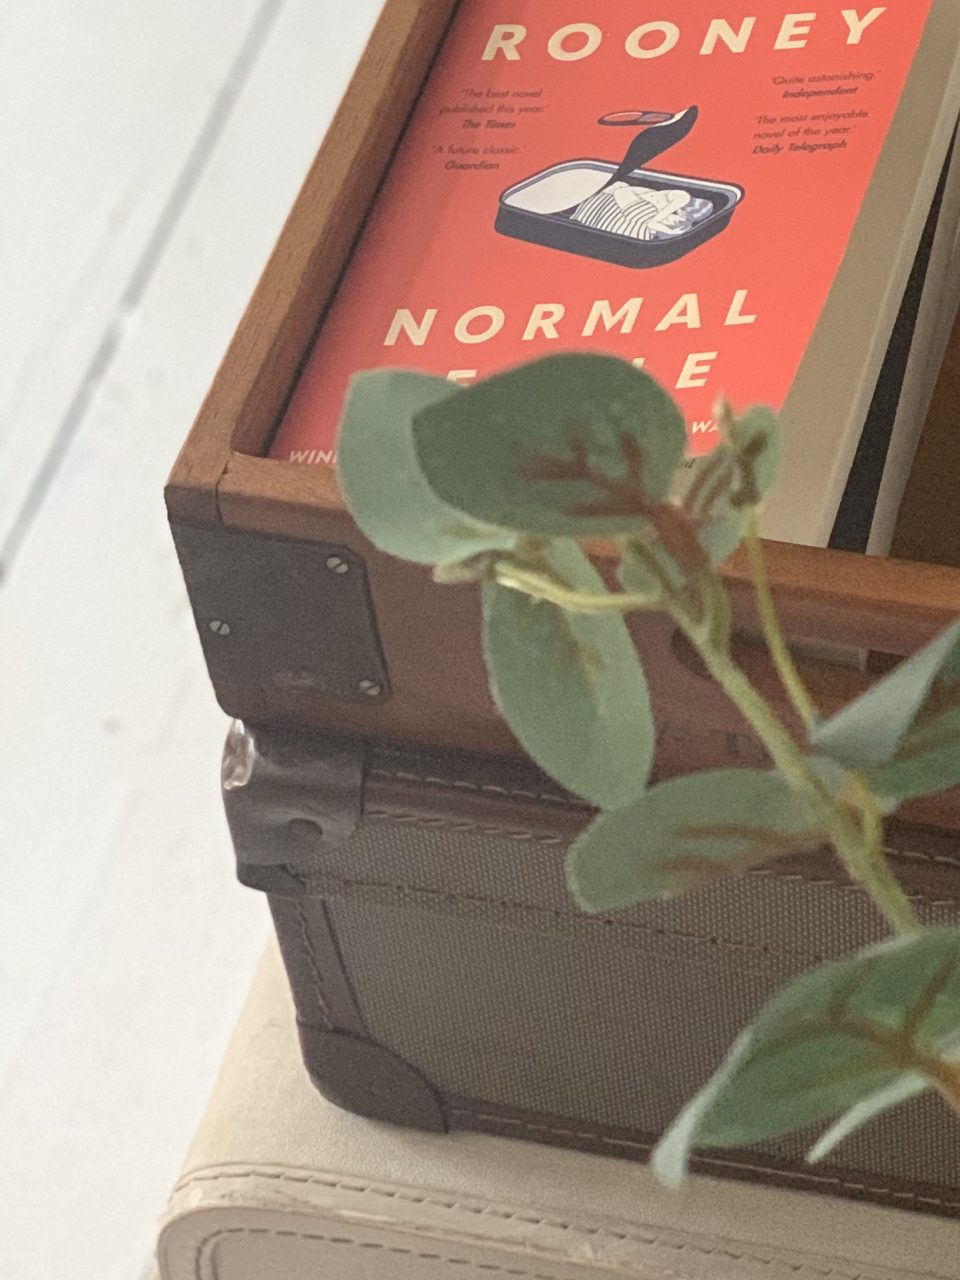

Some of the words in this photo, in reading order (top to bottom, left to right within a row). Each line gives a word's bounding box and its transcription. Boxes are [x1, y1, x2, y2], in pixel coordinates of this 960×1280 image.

[480, 5, 888, 63] ROONEY
[782, 86, 859, 99] Independent
[461, 119, 482, 130] The
[484, 119, 517, 130] Times
[752, 143, 785, 156] Daily
[787, 139, 849, 154] Telegraph
[443, 160, 501, 171] Guardian
[382, 288, 760, 348] NORMAL
